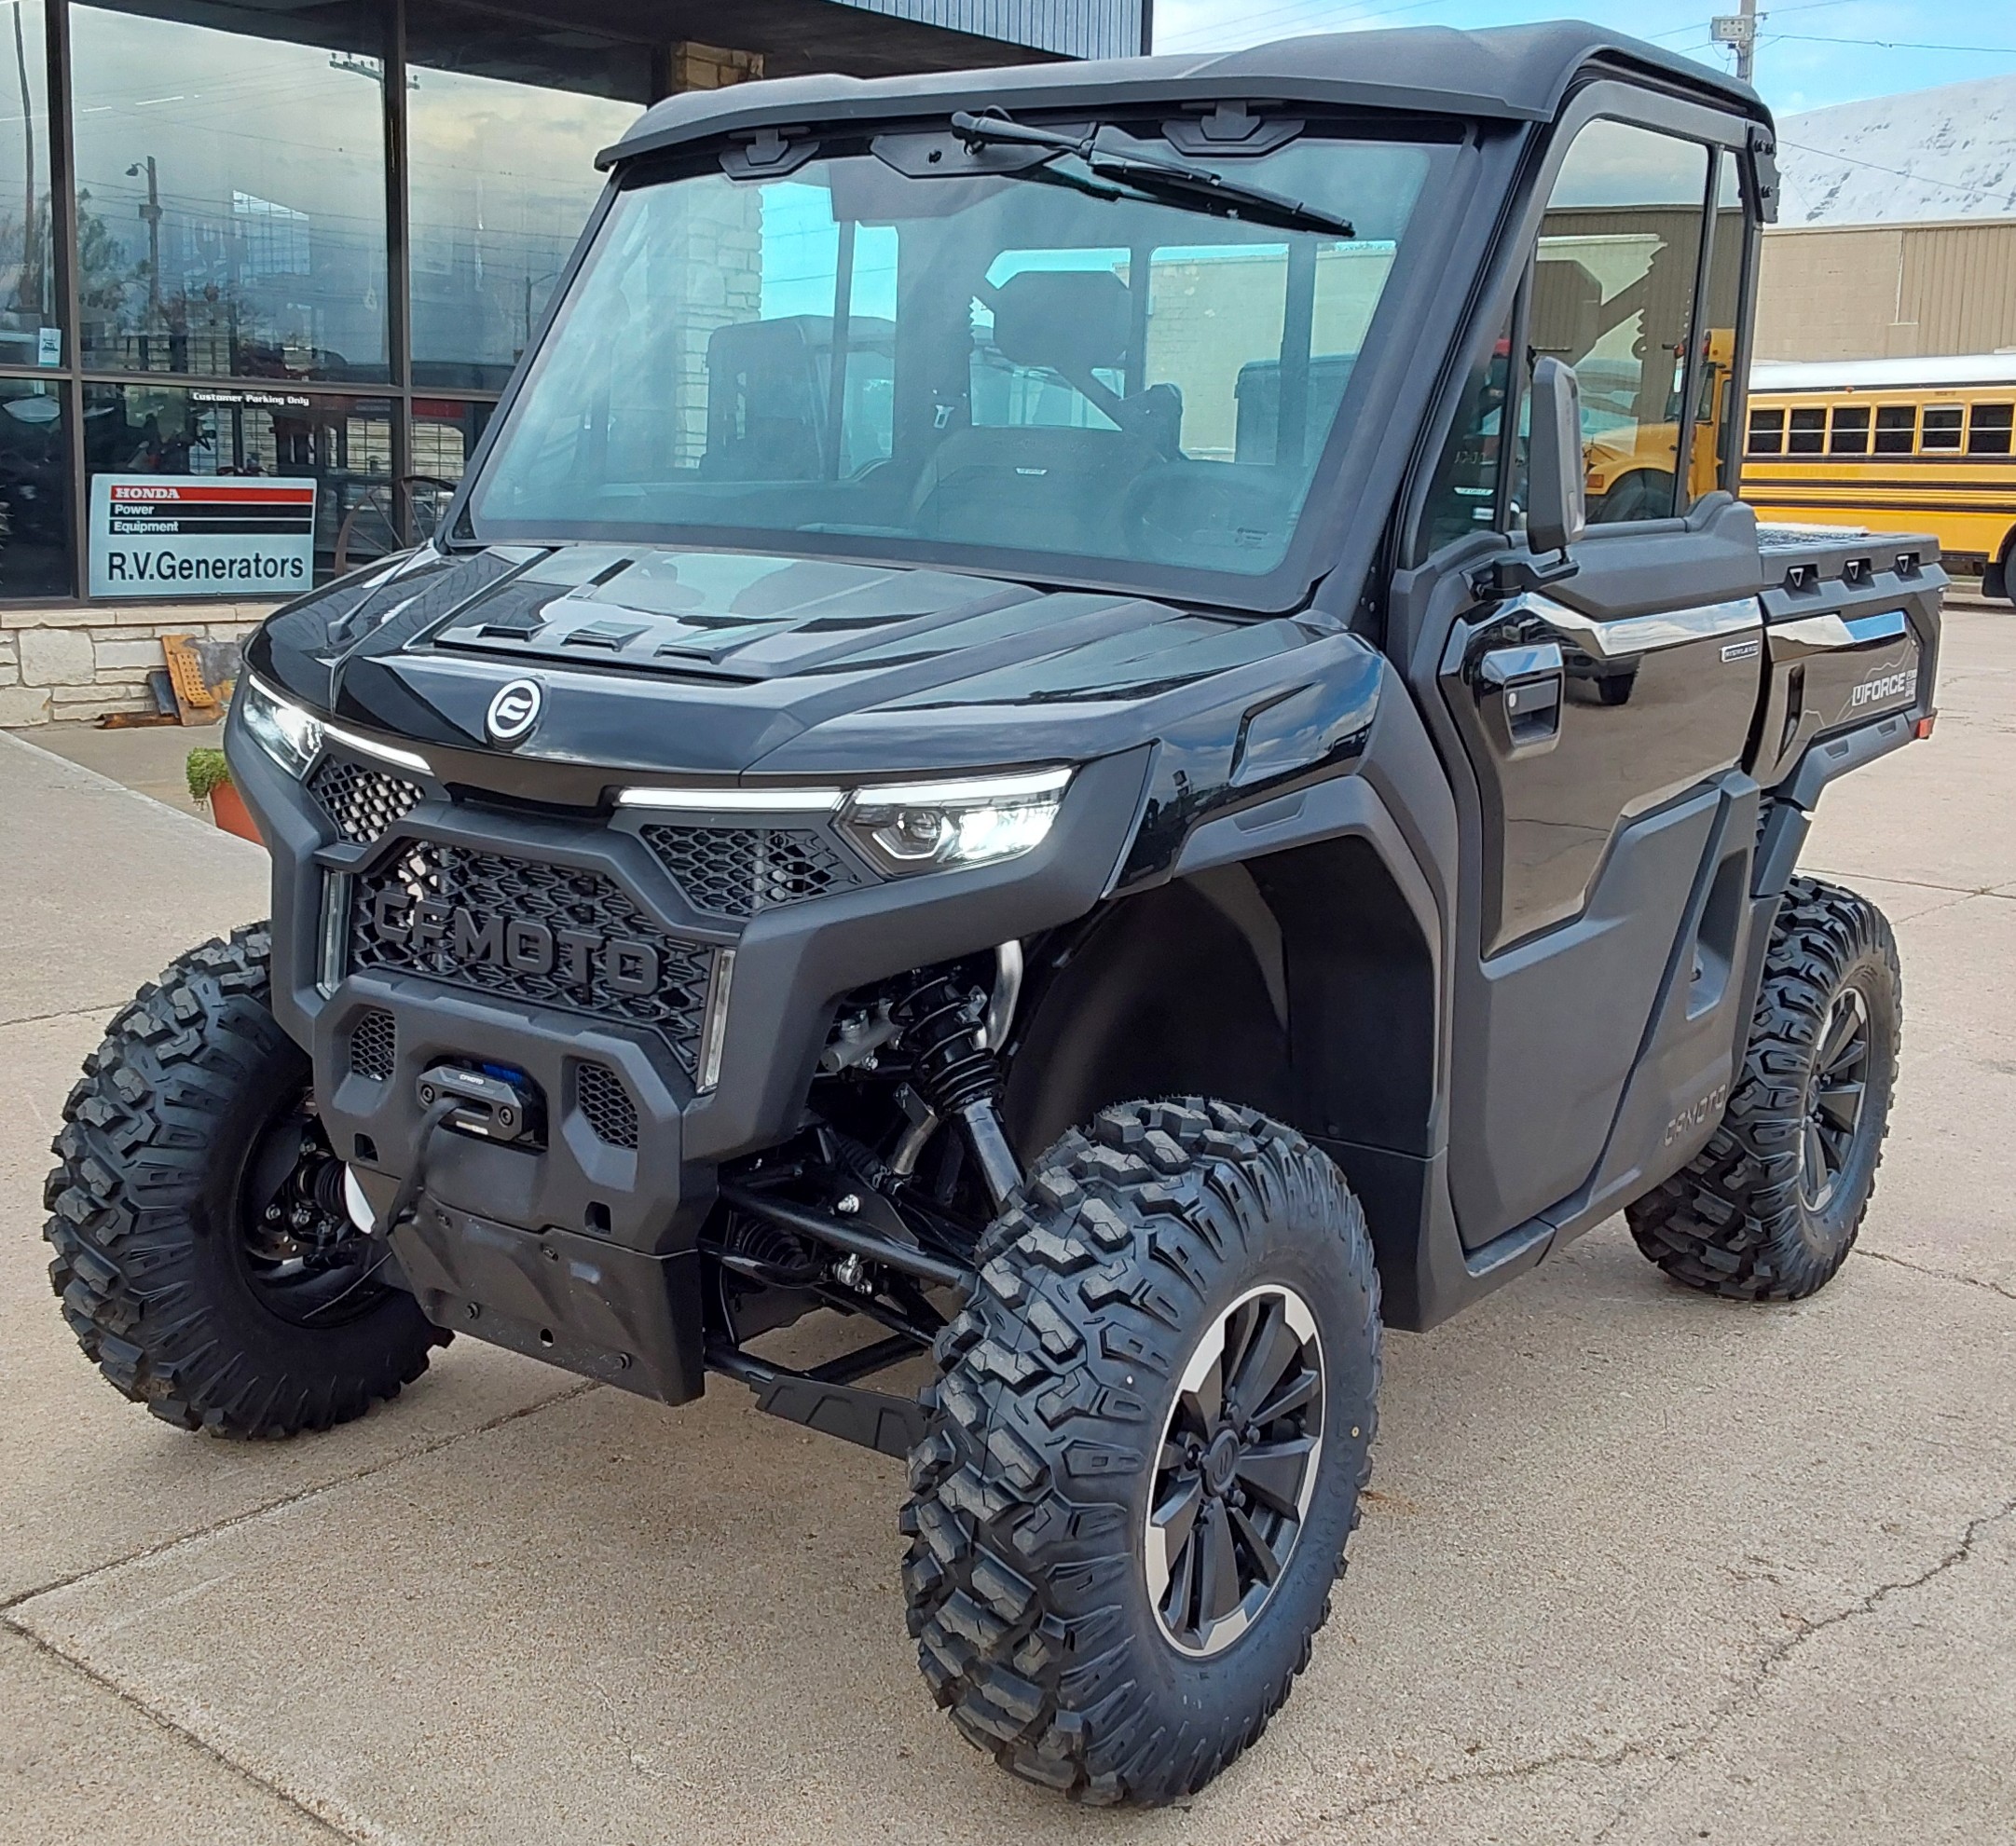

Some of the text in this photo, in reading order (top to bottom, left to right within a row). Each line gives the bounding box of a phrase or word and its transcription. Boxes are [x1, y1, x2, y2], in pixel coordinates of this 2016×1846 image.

[193, 392, 309, 406] Customer Parking Only
[115, 487, 180, 499] HONDA
[114, 504, 155, 515] Power
[114, 521, 179, 533] Equipment
[108, 551, 304, 581] R.V.Generators
[1852, 672, 1906, 706] UFORCE
[374, 889, 659, 996] CFMOTO
